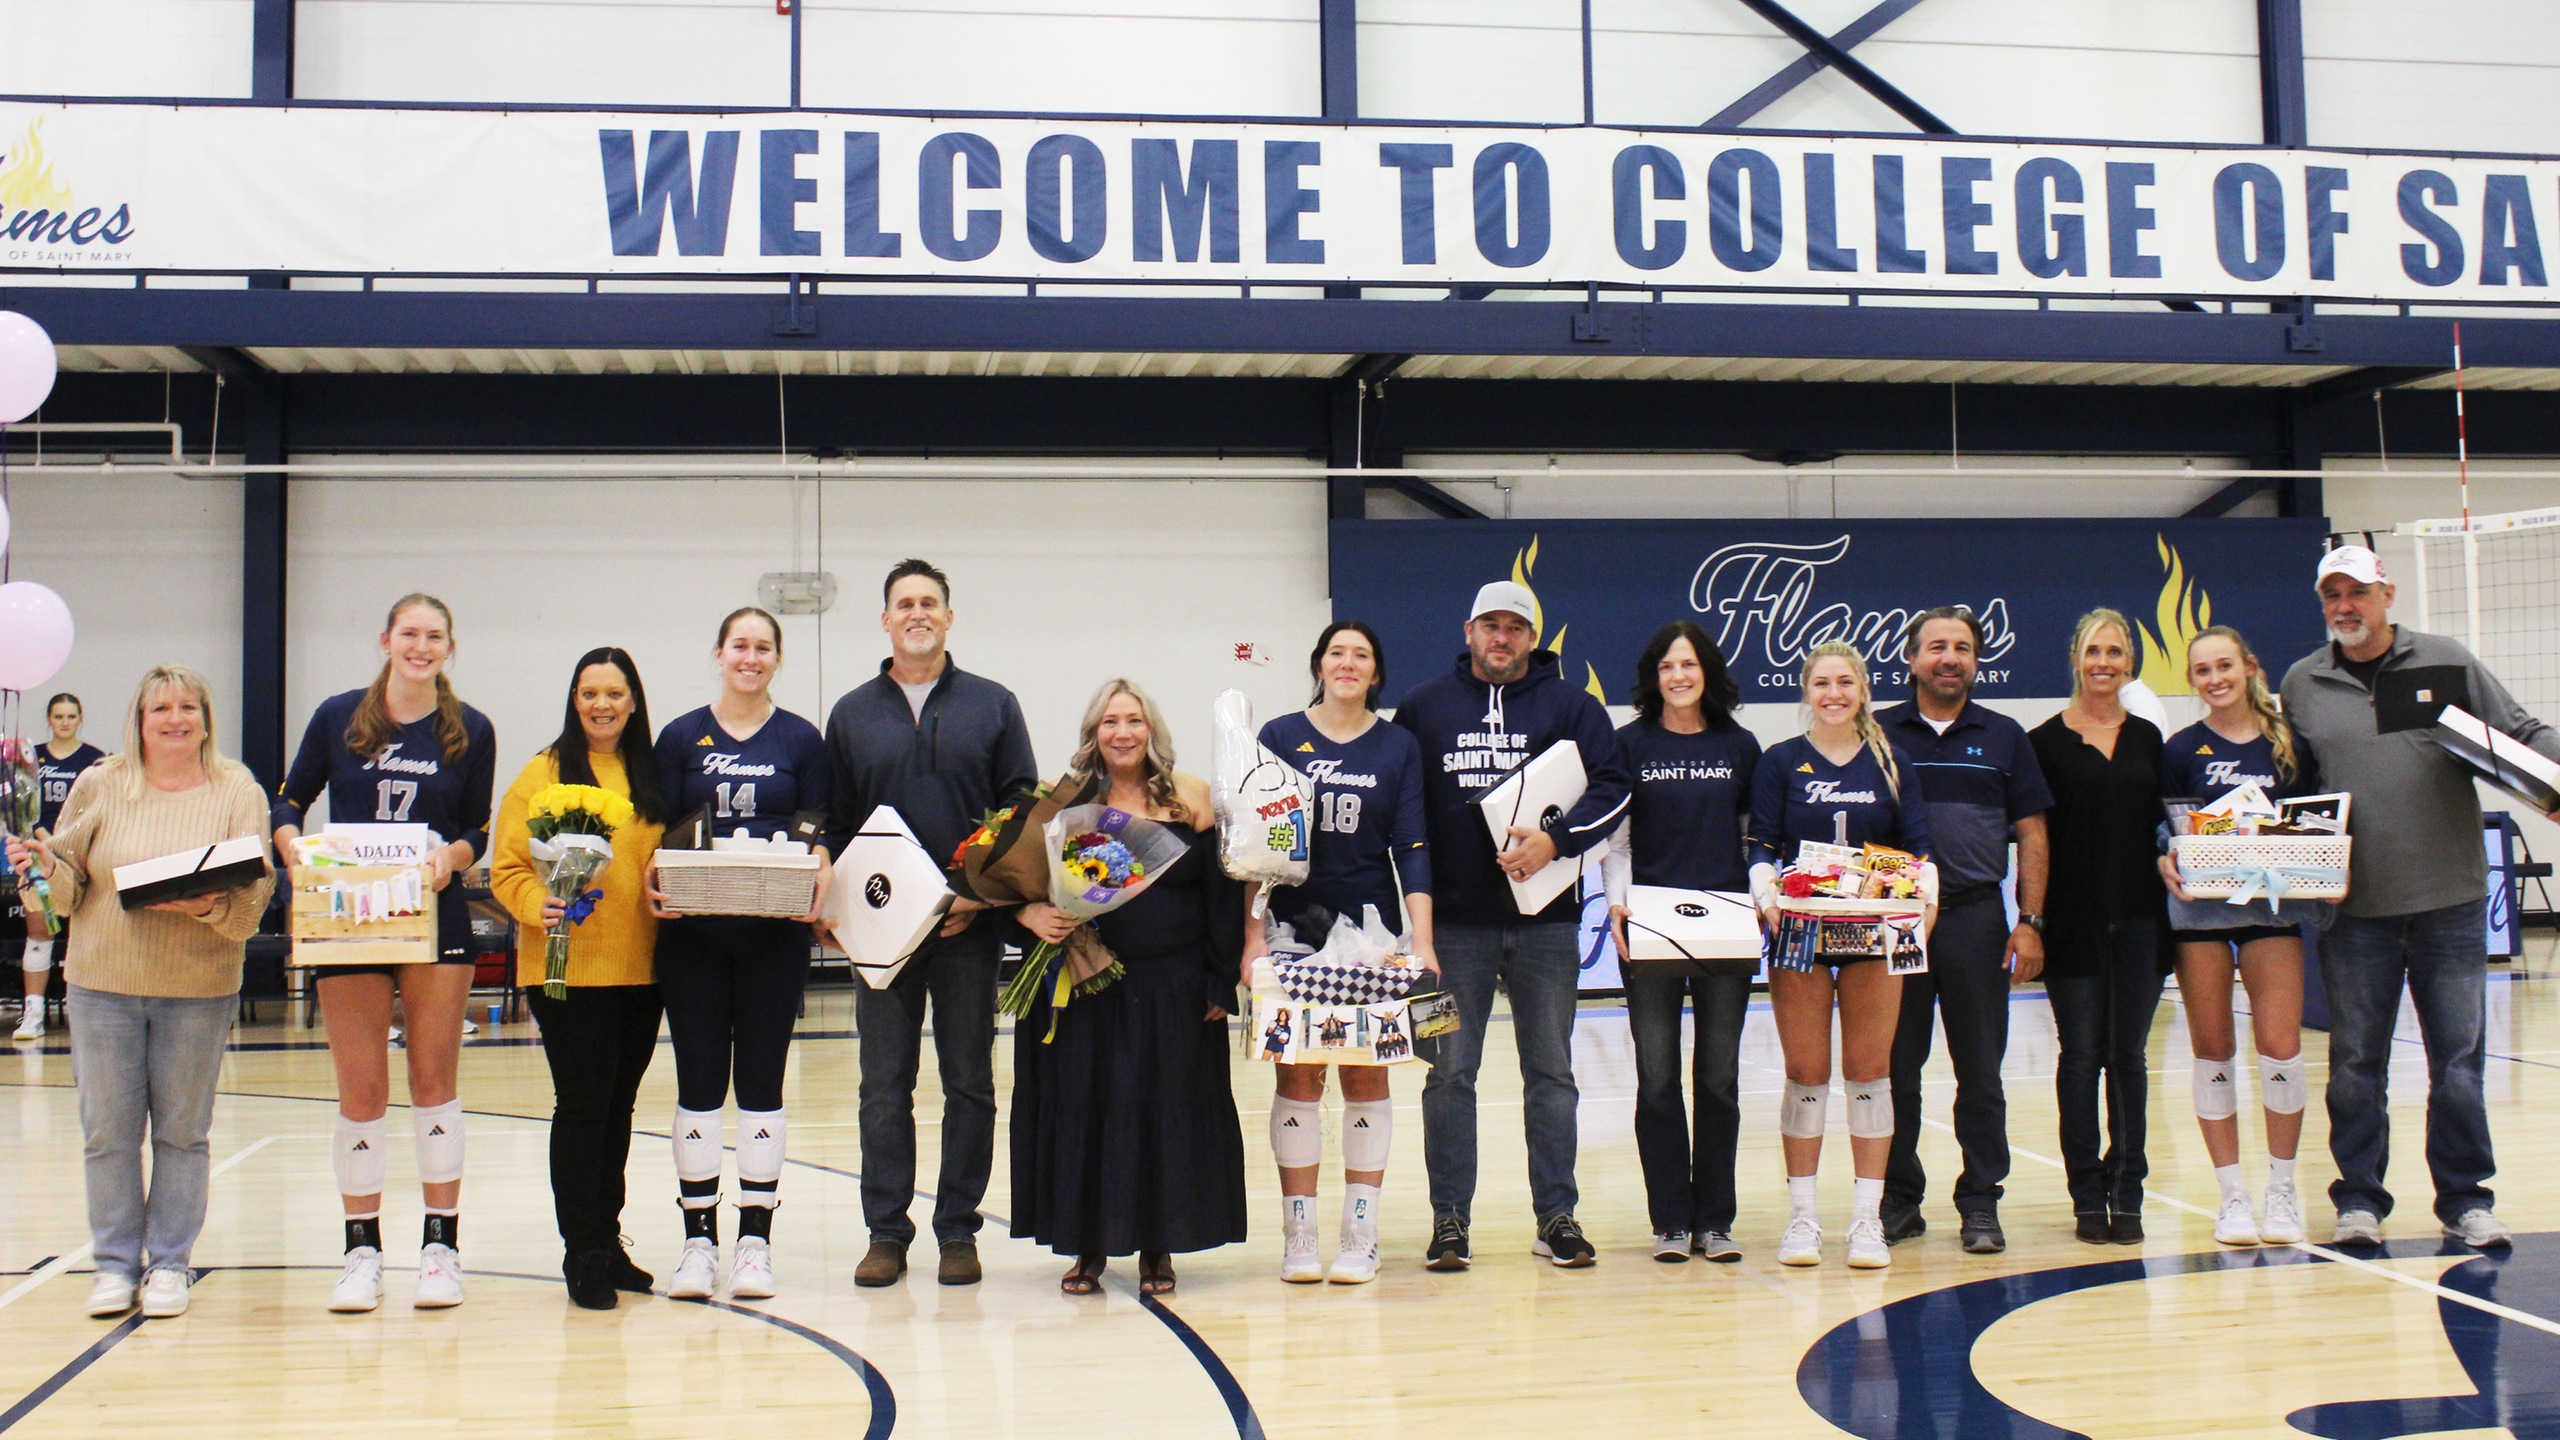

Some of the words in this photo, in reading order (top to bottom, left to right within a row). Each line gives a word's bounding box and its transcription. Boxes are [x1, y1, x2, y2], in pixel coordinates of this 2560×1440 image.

[599, 128, 1326, 264] WELCOME
[1379, 141, 1551, 268] TO
[1612, 144, 2162, 279] COLLEGE
[2213, 162, 2348, 282] OF
[2396, 168, 2560, 287] SA
[8, 250, 28, 260] OF
[37, 251, 82, 261] SAINT
[91, 252, 132, 262] MARY
[1690, 534, 2016, 668] Flams
[1974, 670, 2010, 683] ARY
[1510, 733, 1528, 748] OF
[702, 752, 776, 777] Flames
[1306, 759, 1377, 788] Flames
[1443, 750, 1491, 772] SAINT
[1641, 768, 1687, 782] SAINT
[1690, 767, 1733, 780] MARY
[44, 780, 67, 802] 19
[375, 779, 418, 821] 17
[715, 781, 757, 818] 14
[1804, 780, 1876, 804] Flames
[1320, 791, 1362, 834] 18
[1267, 809, 1309, 861] #1
[1832, 810, 1849, 847] 1
